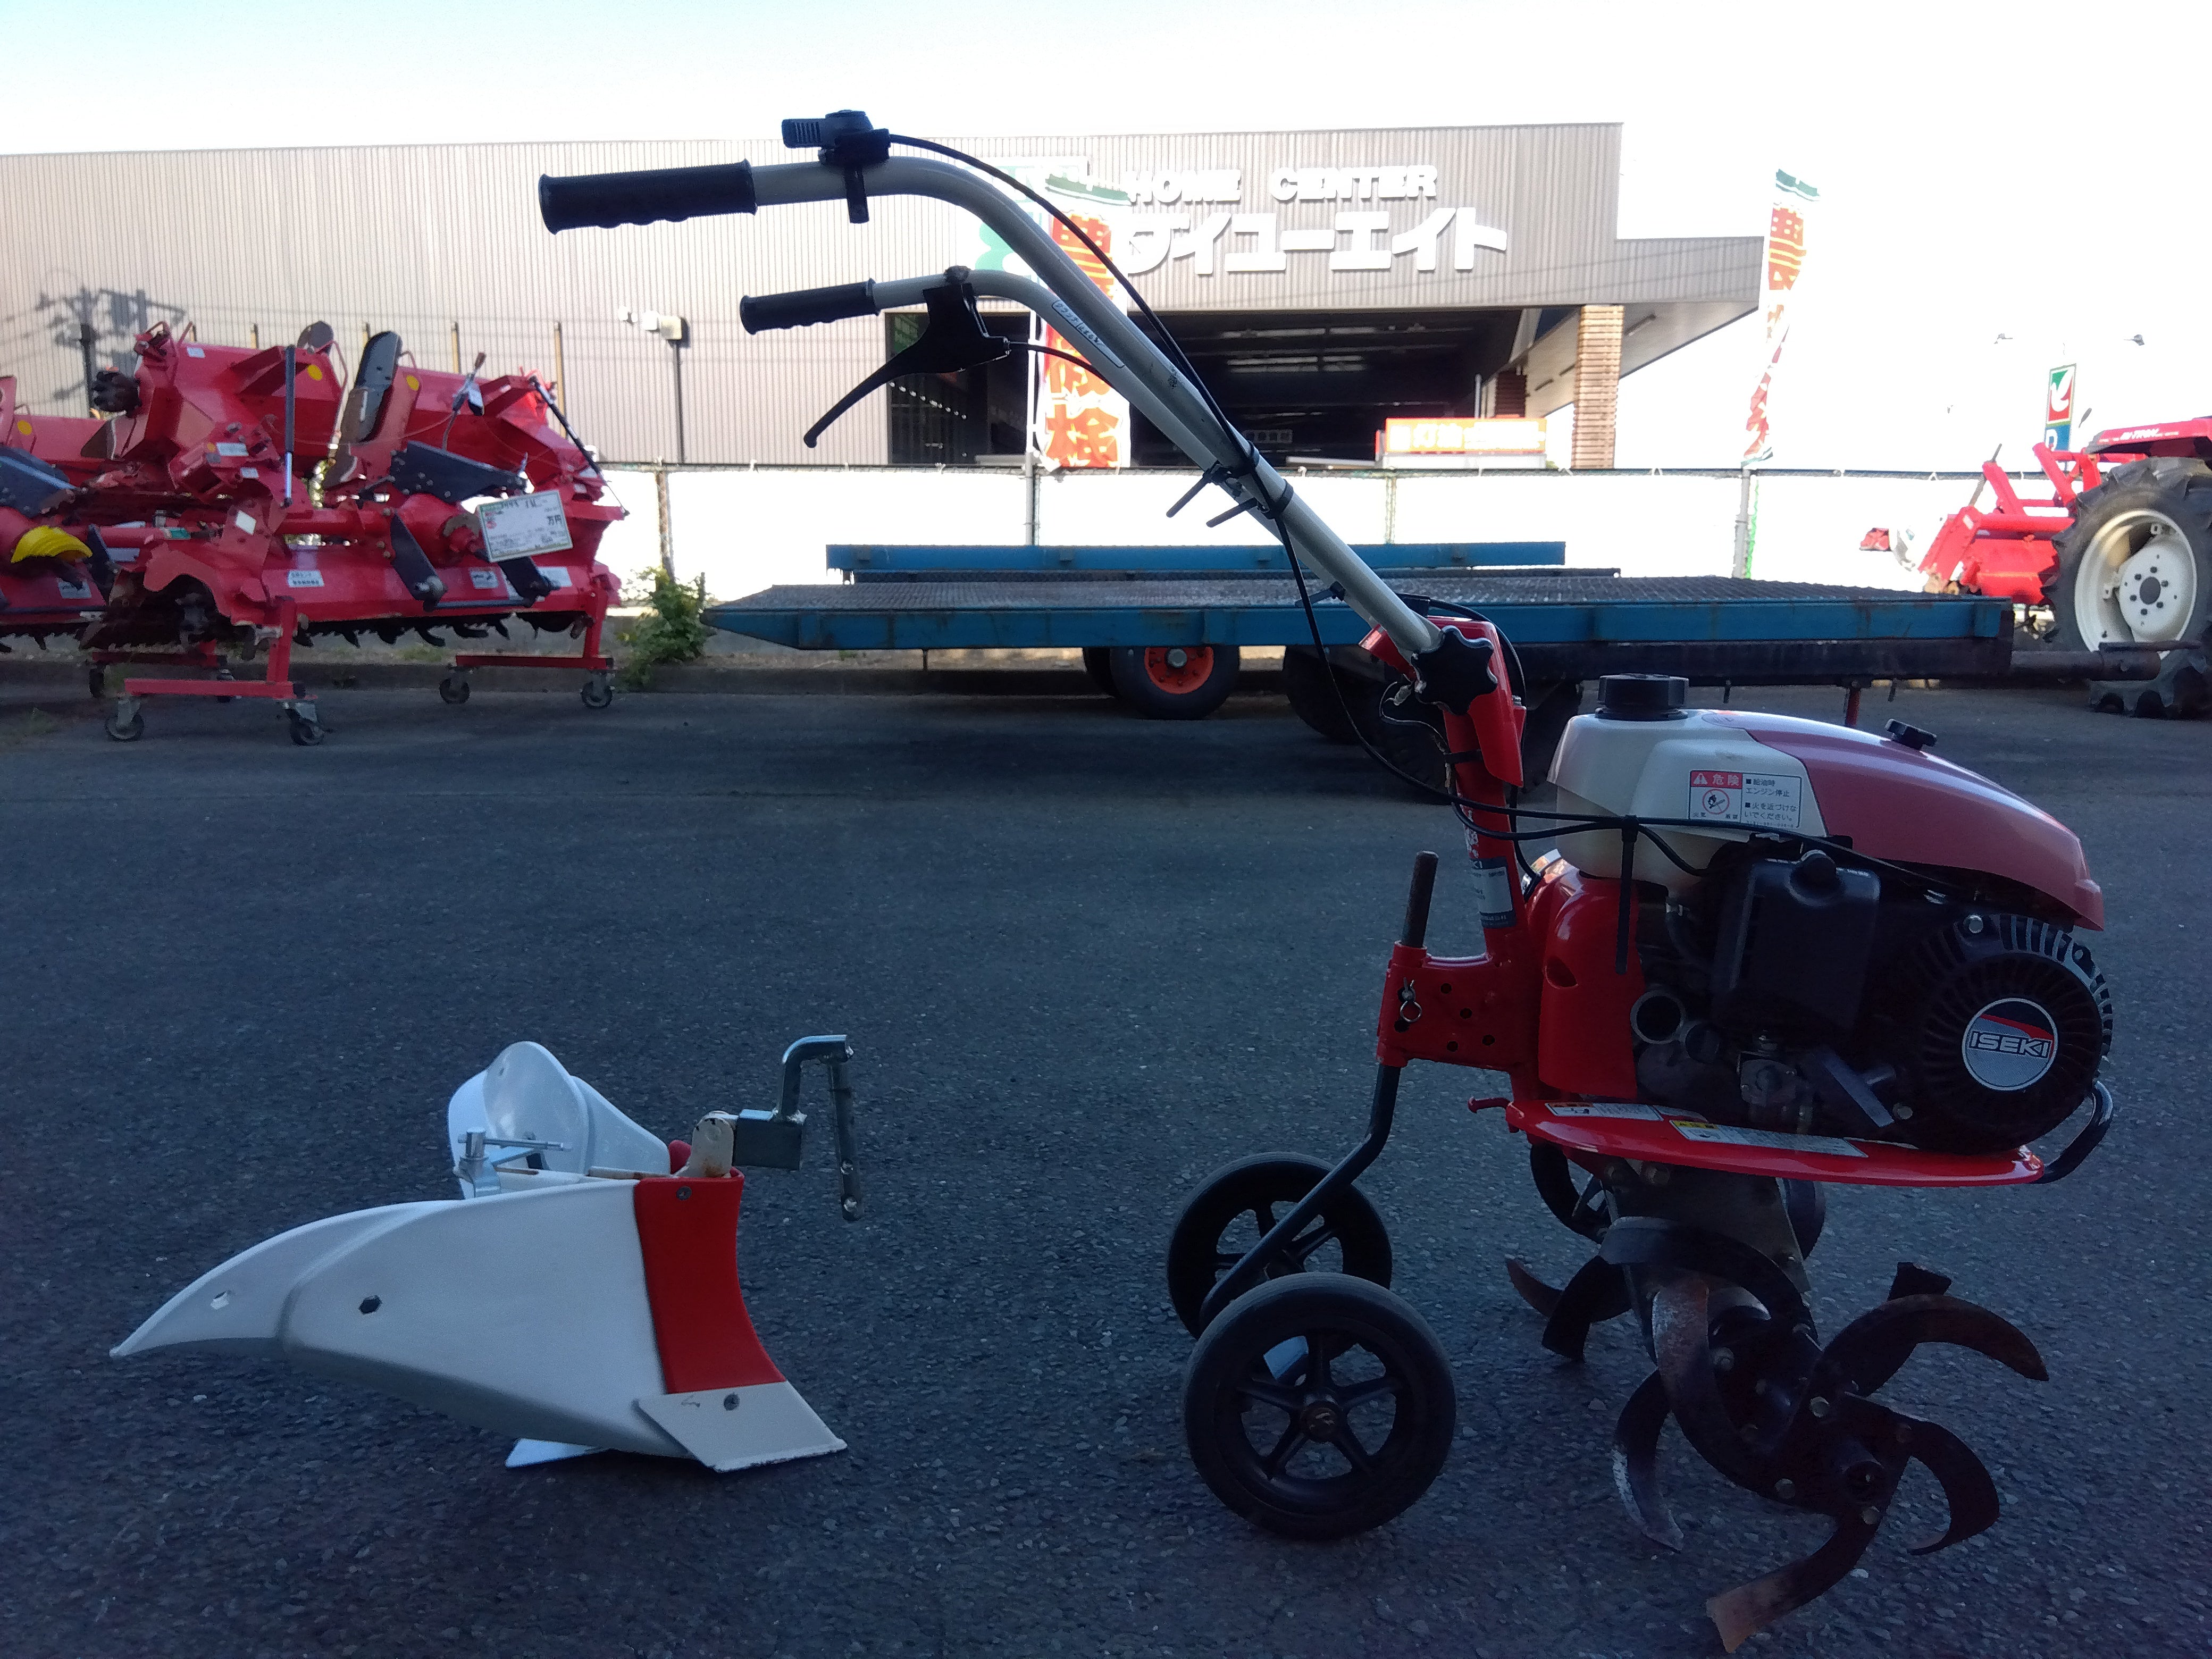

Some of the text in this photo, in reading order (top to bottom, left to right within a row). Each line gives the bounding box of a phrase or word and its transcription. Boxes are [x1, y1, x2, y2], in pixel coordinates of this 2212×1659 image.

[1125, 169, 1241, 203] HOME
[1270, 165, 1438, 200] CENTER
[1712, 773, 1740, 786] 危険
[1753, 778, 1775, 787] 給油時
[1746, 788, 1790, 798] エンジン停止
[1752, 803, 1799, 812] 火を近づけな
[1744, 811, 1792, 822] いでください。
[1970, 1030, 2050, 1058] ISEKI
